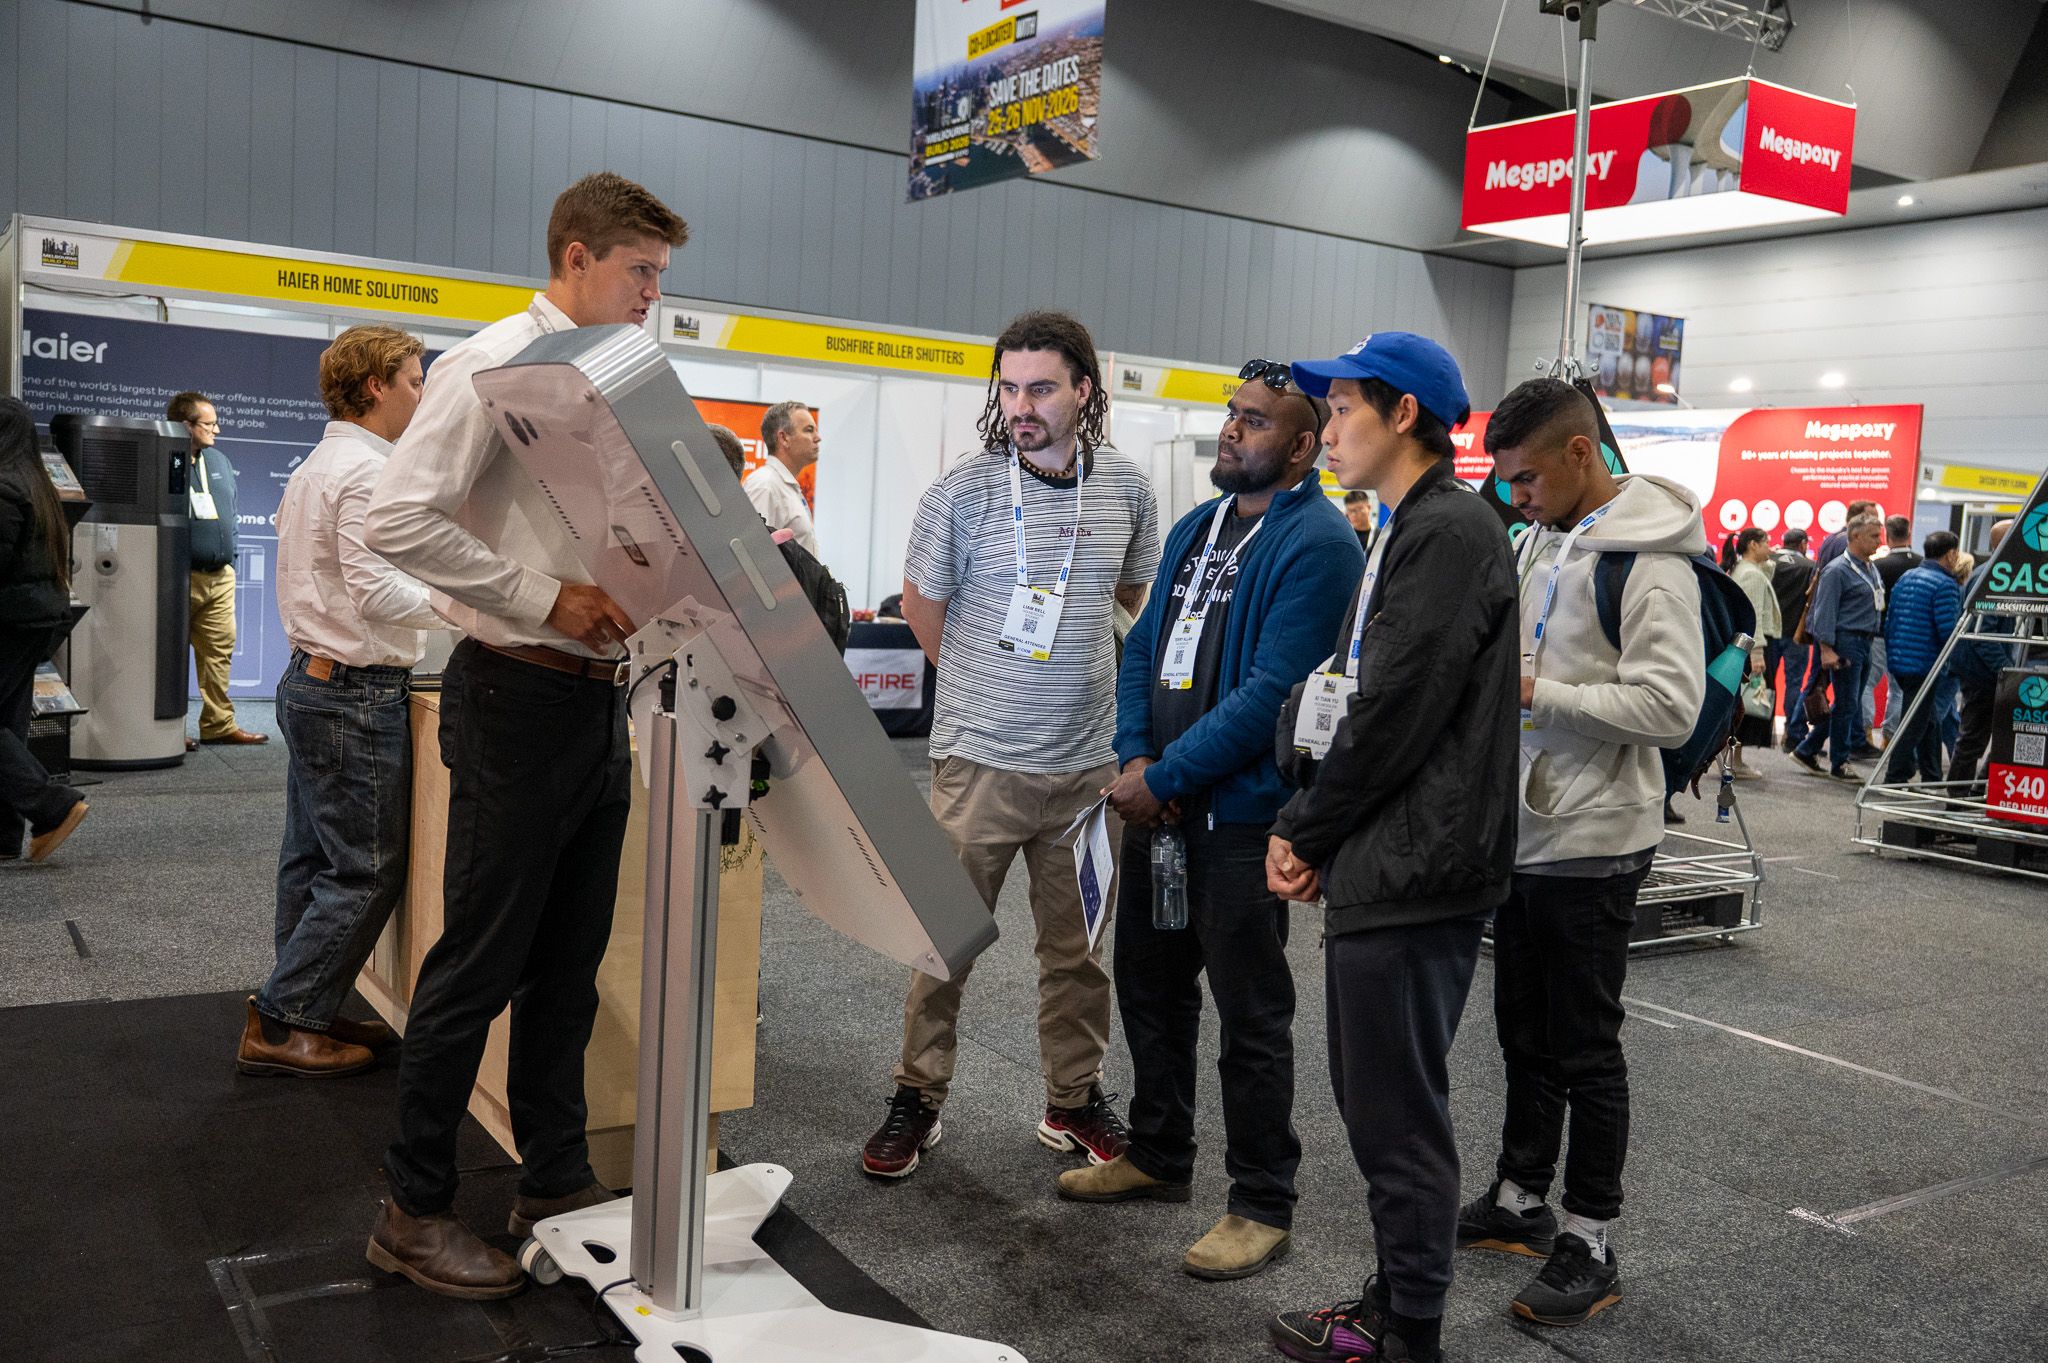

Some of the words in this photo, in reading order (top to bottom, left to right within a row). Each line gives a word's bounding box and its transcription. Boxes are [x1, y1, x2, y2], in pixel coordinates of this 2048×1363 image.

[1016, 16, 1037, 39] WITH
[990, 75, 1018, 108] SAVE
[1019, 67, 1042, 98] THE
[1042, 54, 1080, 92] DATES
[987, 102, 1020, 136] 25-26
[1021, 94, 1046, 126] NOV
[1046, 85, 1079, 118] 2026
[1759, 125, 1841, 172] Megapoxy
[278, 269, 319, 291] HAIER
[323, 275, 363, 296] HOME
[366, 280, 439, 304] SOLUTIONS
[826, 335, 875, 356] BUSHFIRE
[877, 341, 914, 360] ROLLER
[915, 346, 965, 366] SHUTTERS
[43, 376, 57, 386] of
[58, 379, 77, 388] the
[79, 381, 117, 392] world's
[119, 383, 156, 396] largest
[158, 387, 184, 397] bran
[227, 393, 257, 403] offers
[259, 396, 266, 404] a
[22, 389, 71, 401] mmercial,
[73, 393, 94, 403] and
[95, 395, 151, 408] residential
[153, 398, 167, 408] air
[237, 406, 264, 416] water
[266, 408, 307, 421] heating,
[46, 401, 57, 411] in
[58, 404, 97, 415] homes
[99, 407, 120, 418] and
[121, 408, 168, 420] business
[218, 417, 235, 426] the
[236, 418, 269, 429] globe.
[1804, 420, 1895, 442] Megapoxy
[1757, 450, 1780, 462] years
[1780, 449, 1789, 460] of
[1819, 448, 1853, 462] projects
[237, 513, 266, 526] ome
[1004, 634, 1024, 644] GENERAL
[1024, 640, 1047, 650] ATTENDEE
[1298, 737, 1320, 746] GENERAL
[2004, 771, 2045, 800] $40
